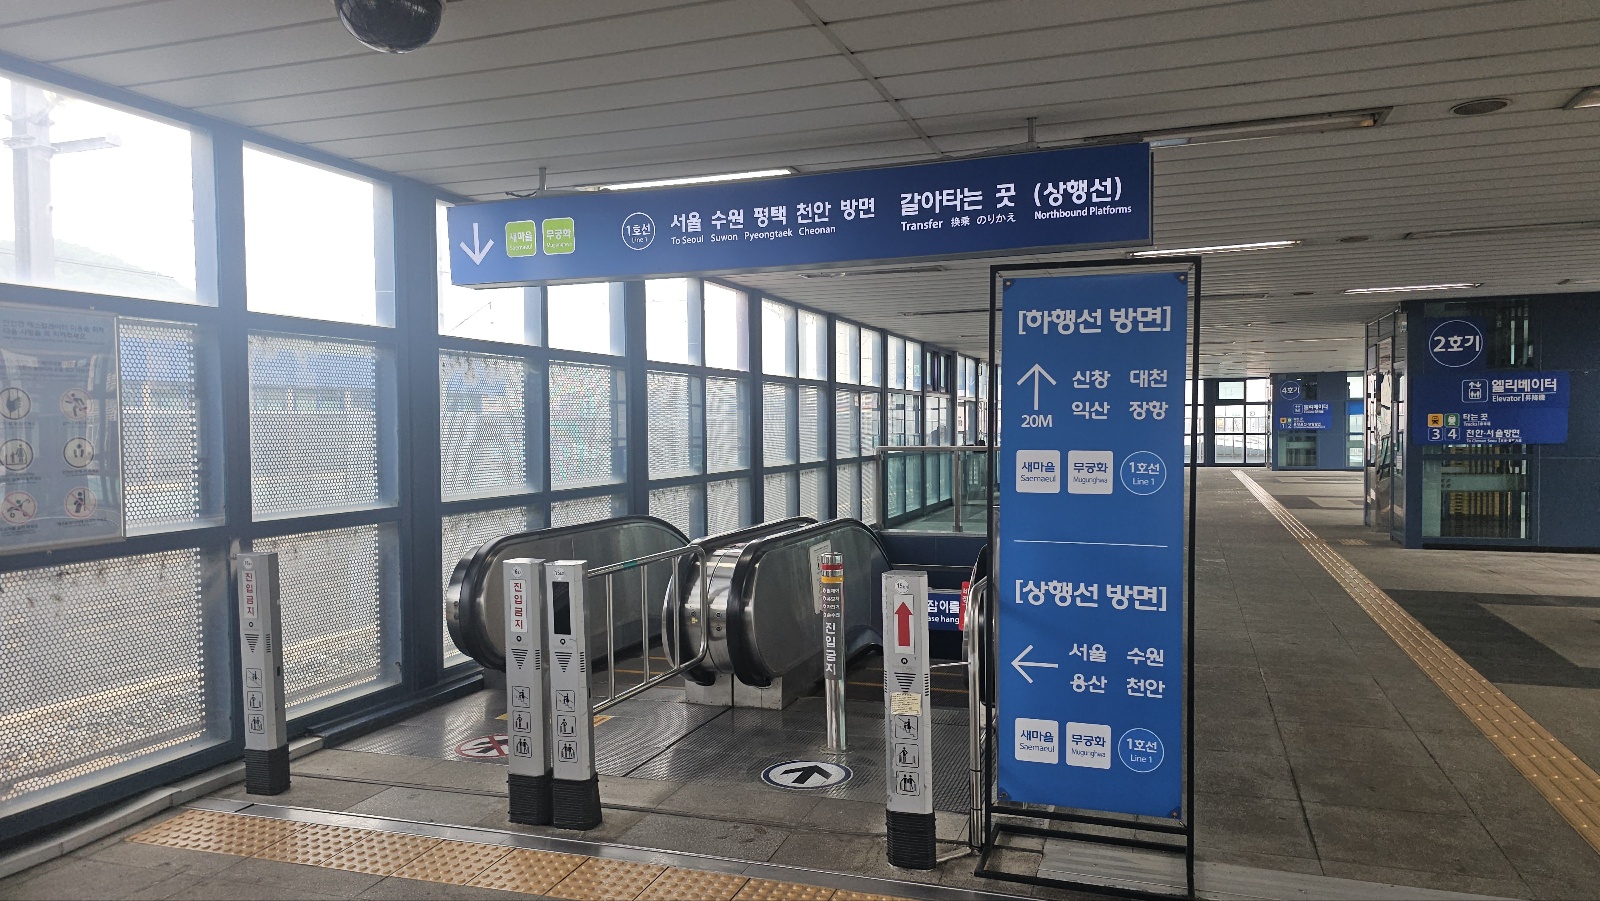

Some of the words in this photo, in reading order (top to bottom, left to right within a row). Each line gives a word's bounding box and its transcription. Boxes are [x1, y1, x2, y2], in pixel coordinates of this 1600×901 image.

[670, 211, 702, 233] 서울
[711, 209, 744, 230] 수원
[753, 205, 787, 227] 평택
[796, 201, 832, 224] 천안
[840, 197, 875, 220] 방면
[900, 187, 983, 216] 갈아타는
[995, 183, 1016, 208] 곳
[1034, 176, 1122, 207] (상행선)
[625, 222, 651, 237] 1호선
[671, 236, 681, 245] To
[682, 234, 704, 244] Seoul
[711, 233, 738, 242] Suwon
[744, 228, 793, 241] Pyeongtaek
[799, 225, 836, 236] Cheonan
[901, 219, 943, 231] Transfer
[976, 213, 1017, 225] のりかえ
[1034, 207, 1087, 220] Northbound
[1089, 205, 1132, 216] Platforms
[509, 230, 533, 243] 새마을
[546, 228, 571, 240] 무궁화
[1018, 308, 1102, 335] [하행선
[1109, 305, 1172, 333] 방면]
[1433, 335, 1480, 352] 2호기
[1072, 369, 1111, 389] 신창
[1129, 368, 1168, 388] 대천
[1491, 378, 1557, 393] 엘리베이터
[1281, 386, 1300, 394] 4호기
[1492, 395, 1521, 403] Elevator
[1071, 400, 1110, 420] 익산
[1129, 400, 1168, 420] 장항
[1462, 413, 1479, 421] 타는
[1480, 413, 1488, 421] 곳
[1021, 414, 1053, 428] 20M
[1431, 428, 1440, 440] 3
[1447, 428, 1457, 440] 4
[1021, 461, 1056, 473] 새마을
[1073, 462, 1109, 474] 무궁화
[1129, 461, 1160, 475] 1호선
[1020, 474, 1056, 482] Saemaeul
[1073, 476, 1108, 484] Mugunghwa
[1132, 477, 1149, 485] Line
[1150, 477, 1155, 485] 1
[245, 572, 255, 617] 진입금지
[1015, 579, 1099, 608] [상행선
[1106, 584, 1167, 612] 방면]
[514, 582, 523, 630] 진입금지
[940, 614, 960, 625] hang
[825, 621, 837, 676] 진입금지
[1068, 643, 1107, 663] 서울
[1126, 647, 1164, 667] 수원
[1069, 673, 1107, 694] 용산
[1126, 677, 1166, 699] 천안
[1020, 729, 1054, 743] 새마을
[1071, 734, 1106, 748] 무궁화
[1019, 742, 1055, 753] Saemaeul
[1126, 738, 1157, 753] 1호선
[1071, 748, 1106, 758] Mugunghwa
[1130, 754, 1147, 763] Line
